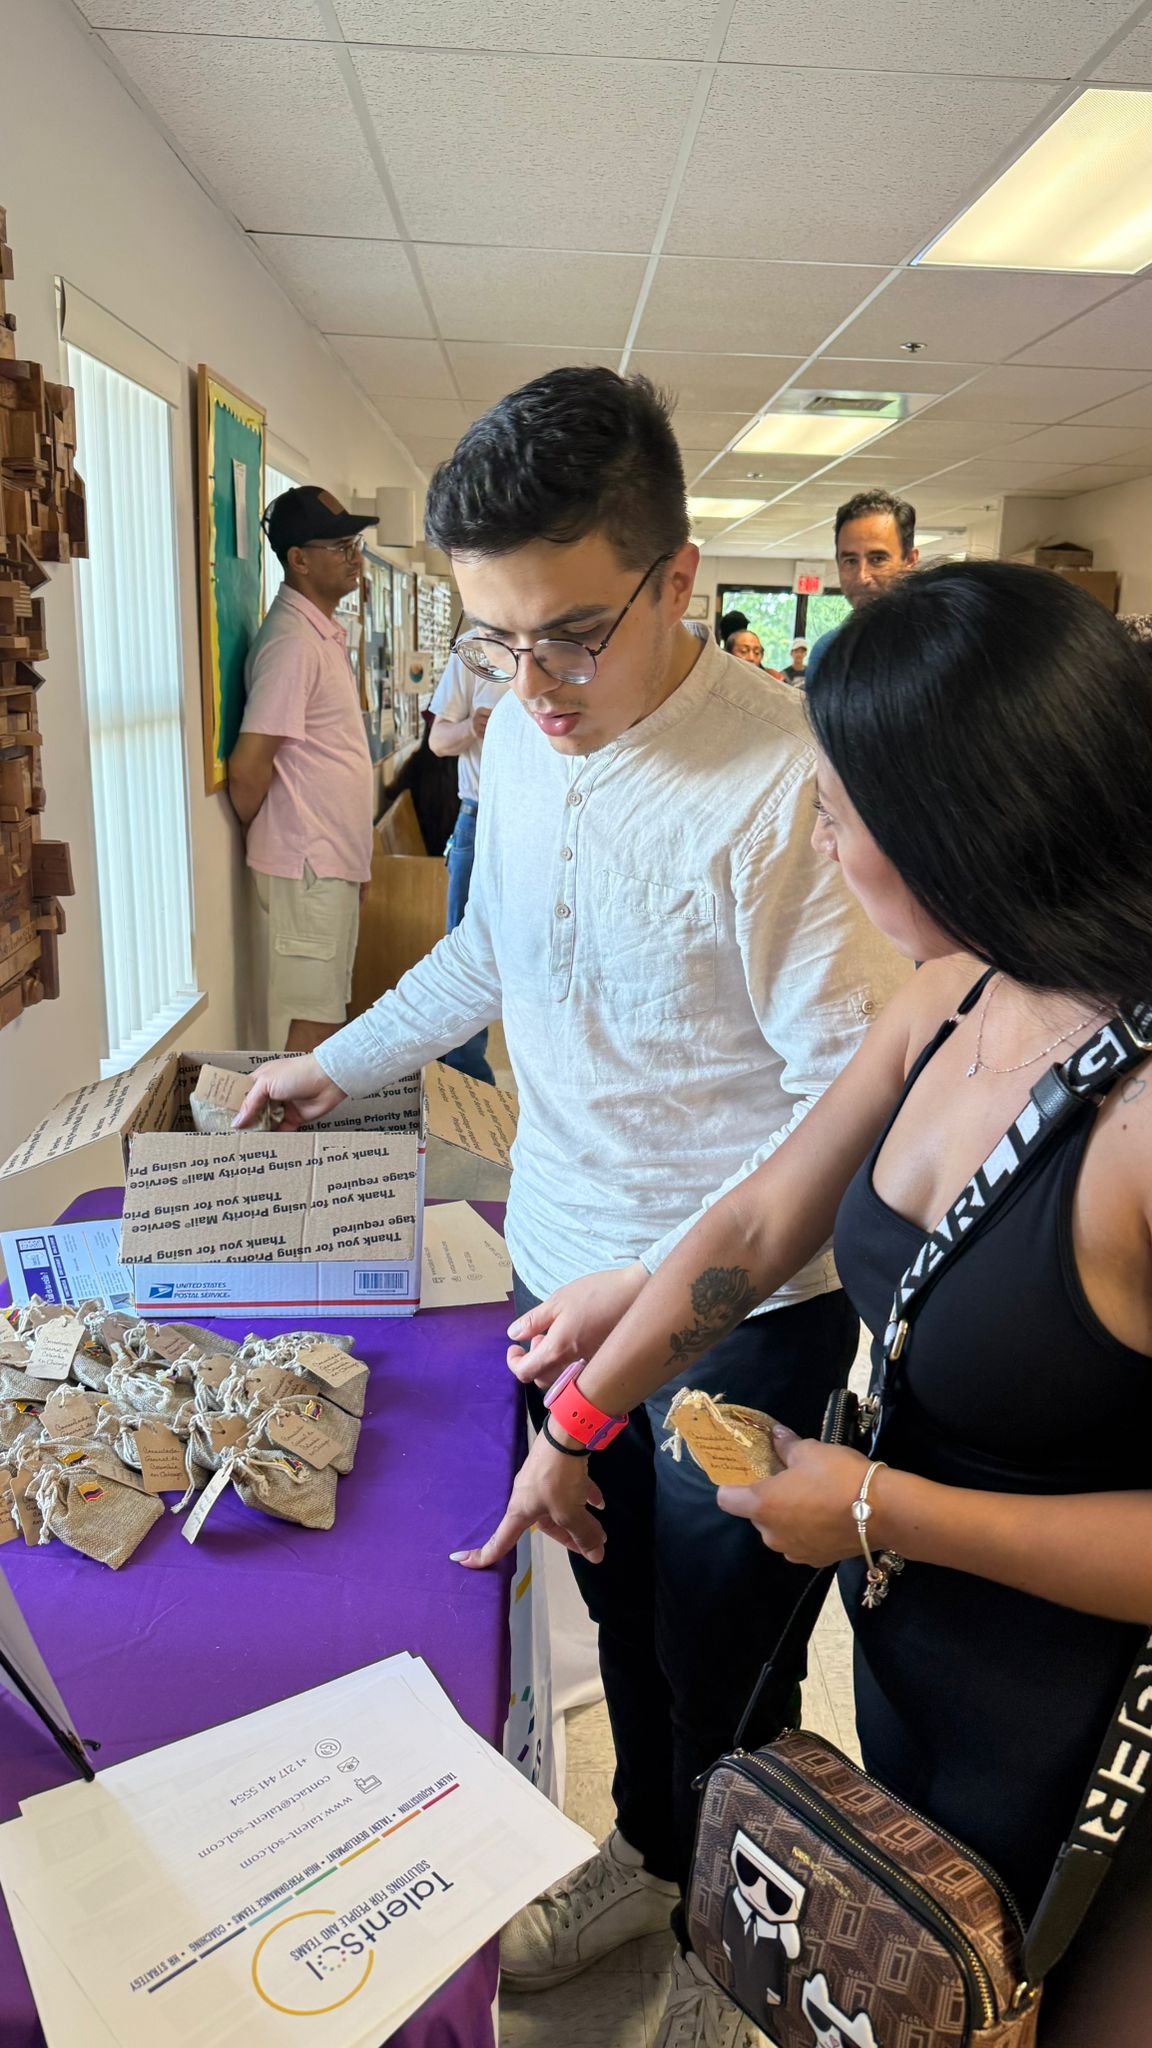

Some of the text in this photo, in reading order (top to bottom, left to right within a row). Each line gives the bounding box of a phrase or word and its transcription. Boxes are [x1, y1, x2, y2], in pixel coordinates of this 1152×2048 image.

[383, 1088, 401, 1098] you
[403, 1086, 418, 1094] for
[317, 1121, 332, 1130] for
[334, 1116, 362, 1127] using
[364, 1112, 401, 1124] Priority
[327, 1151, 349, 1163] you
[353, 1147, 390, 1161] Thank
[130, 1149, 278, 1177] Thank you for using Pri
[269, 1160, 302, 1171] using
[305, 1157, 324, 1166] for
[218, 1165, 265, 1178] Priority
[130, 1177, 178, 1189] Service
[327, 1171, 416, 1194] stage required
[332, 1193, 354, 1205] you
[357, 1188, 396, 1203] Thank
[123, 1192, 282, 1221] Thank you for using Prio
[273, 1202, 307, 1214] using
[311, 1199, 329, 1209] for
[221, 1207, 269, 1221] Priority
[131, 1219, 181, 1233] Service
[332, 1214, 416, 1237] tage required
[219, 1239, 243, 1251] you
[246, 1235, 286, 1249] Thank
[337, 1238, 360, 1251] you
[362, 1231, 402, 1246] Thank
[157, 1248, 193, 1261] using
[196, 1245, 216, 1255] for
[277, 1247, 312, 1259] using
[315, 1243, 334, 1252] for
[278, 1763, 297, 1779] 217
[258, 1775, 277, 1790] 441
[230, 1786, 259, 1807] 5554
[198, 1775, 331, 1859] contact@talent-sol.com
[239, 1796, 353, 1869] www.talent-sol.com
[129, 1771, 457, 1993] TALENT ACQUISITION TALENT DEVELOPMENT HIGH PERFORMANCE TEAMS COACHING HR STRATEGY
[290, 1859, 431, 1962] SOLUTIONS FOR PEOPLE AND TEAMS
